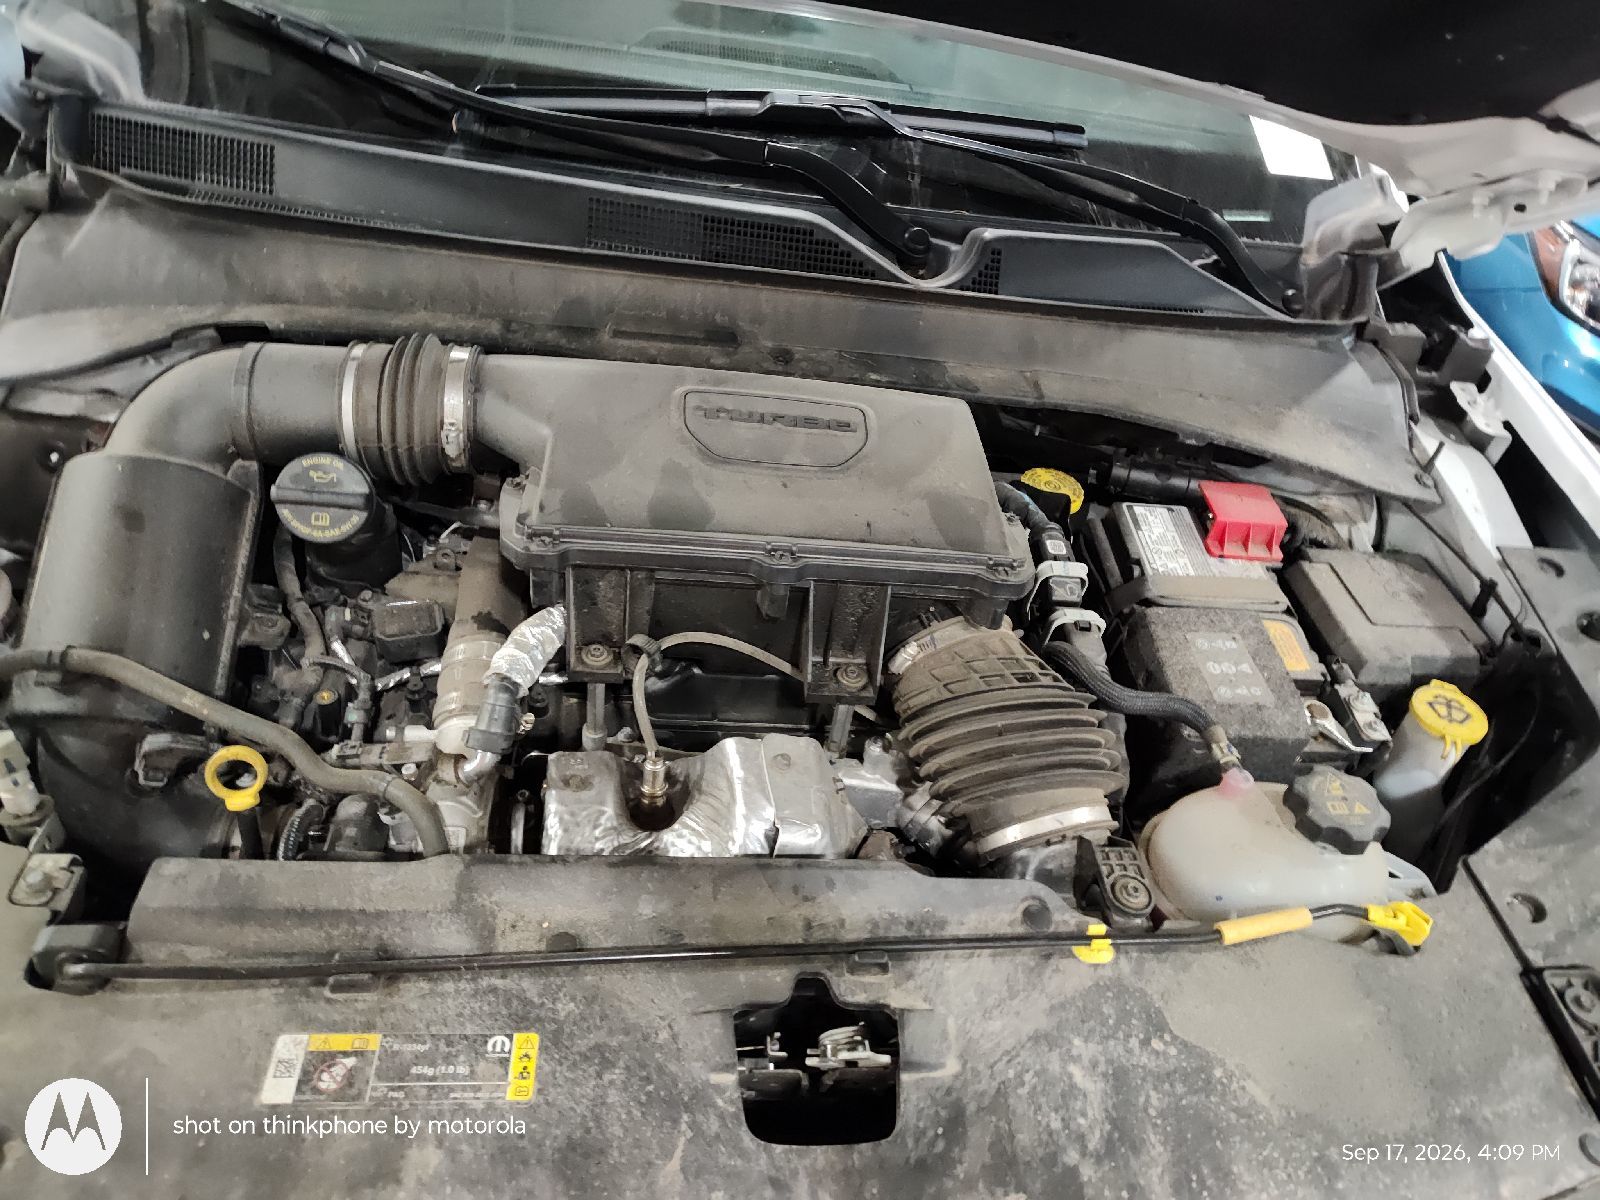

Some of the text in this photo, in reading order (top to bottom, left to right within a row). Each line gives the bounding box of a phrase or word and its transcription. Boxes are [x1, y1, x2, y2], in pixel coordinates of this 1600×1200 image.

[302, 457, 331, 467] ENGINE
[410, 1065, 435, 1076] 454g
[436, 1065, 454, 1075] (1.0
